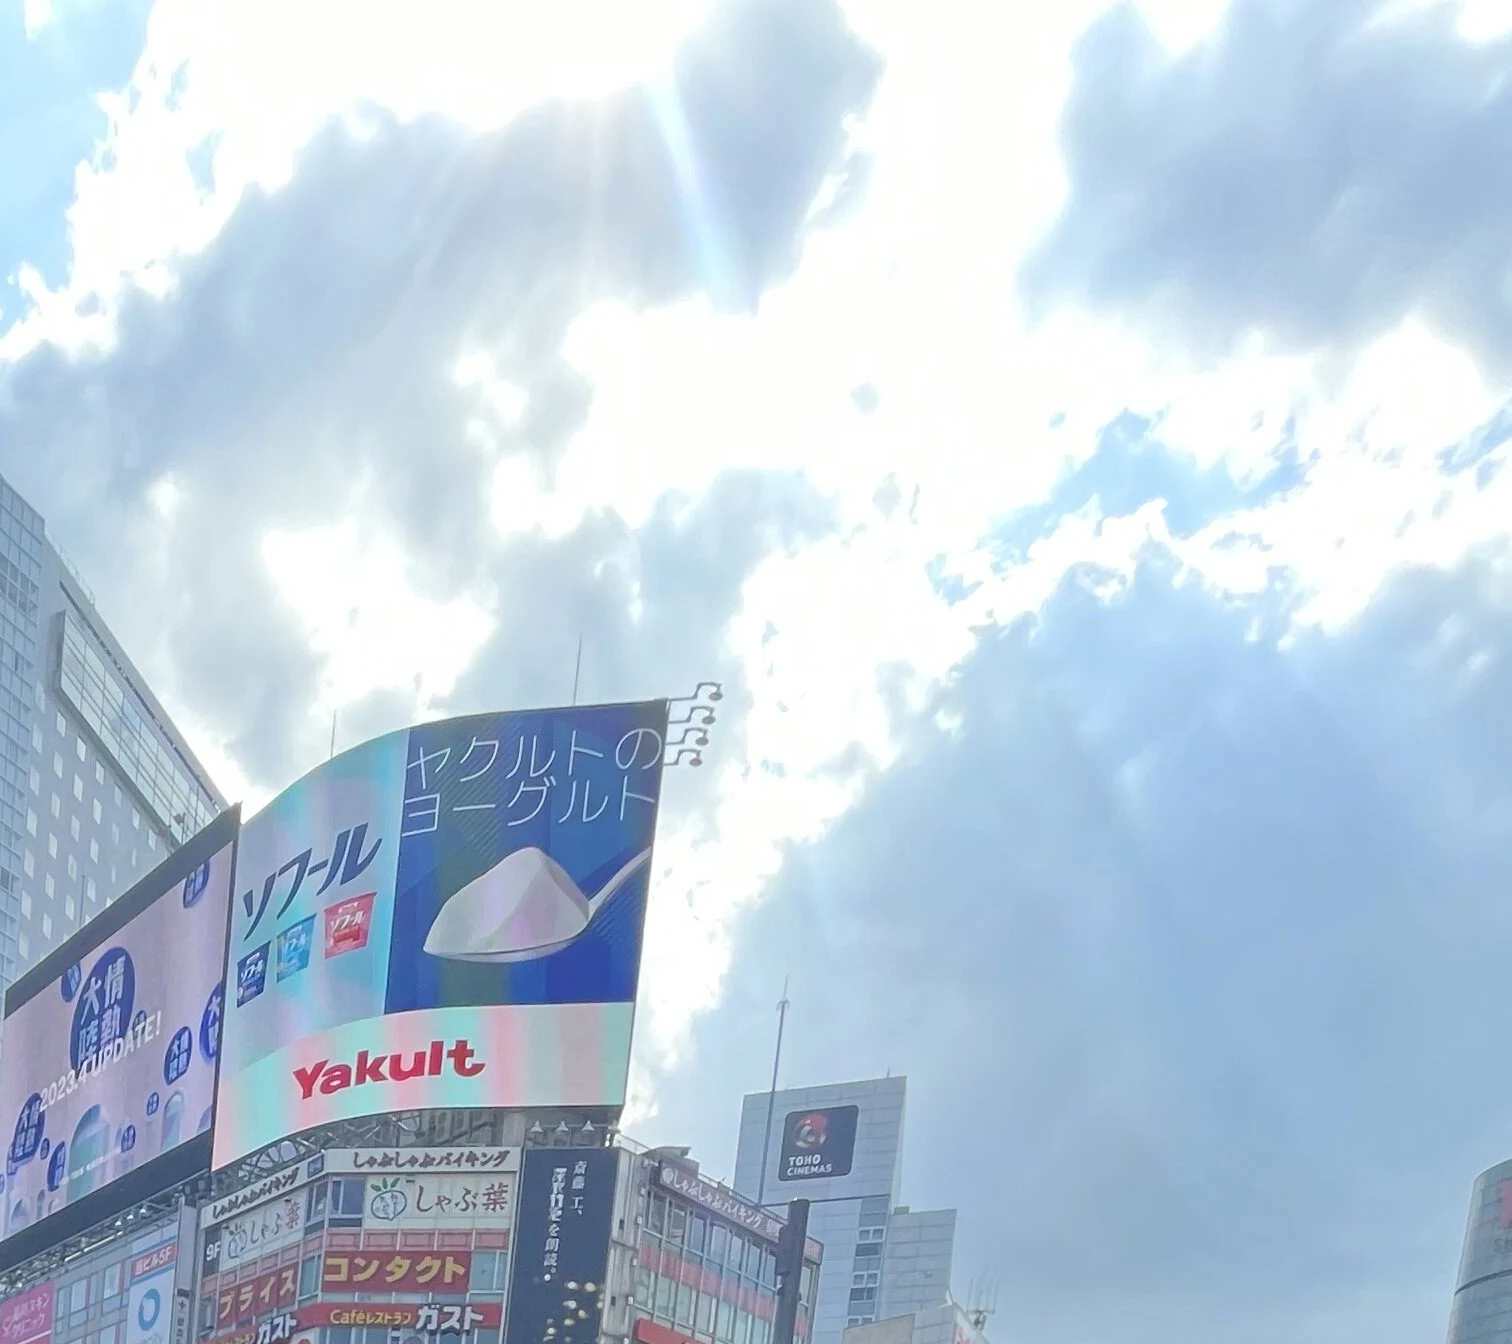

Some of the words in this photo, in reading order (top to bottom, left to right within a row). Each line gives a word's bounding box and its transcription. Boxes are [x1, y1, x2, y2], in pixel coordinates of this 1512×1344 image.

[405, 726, 663, 790] ヤクルトの
[400, 774, 657, 837] ヨーグルト
[242, 821, 383, 942] ソフール
[90, 1008, 162, 1078] UPDATE!
[292, 1040, 486, 1100] Yakult
[353, 1151, 510, 1168] しゃぶしゃぶバイキング
[787, 1163, 833, 1176] CINEMAS
[788, 1154, 821, 1167] TOHO
[416, 1182, 509, 1213] しゃぶ葉
[206, 1242, 221, 1261] 9F
[324, 1255, 466, 1283] コンタクト
[330, 1309, 412, 1326] Caféレストラン
[416, 1305, 484, 1331] ガスト
